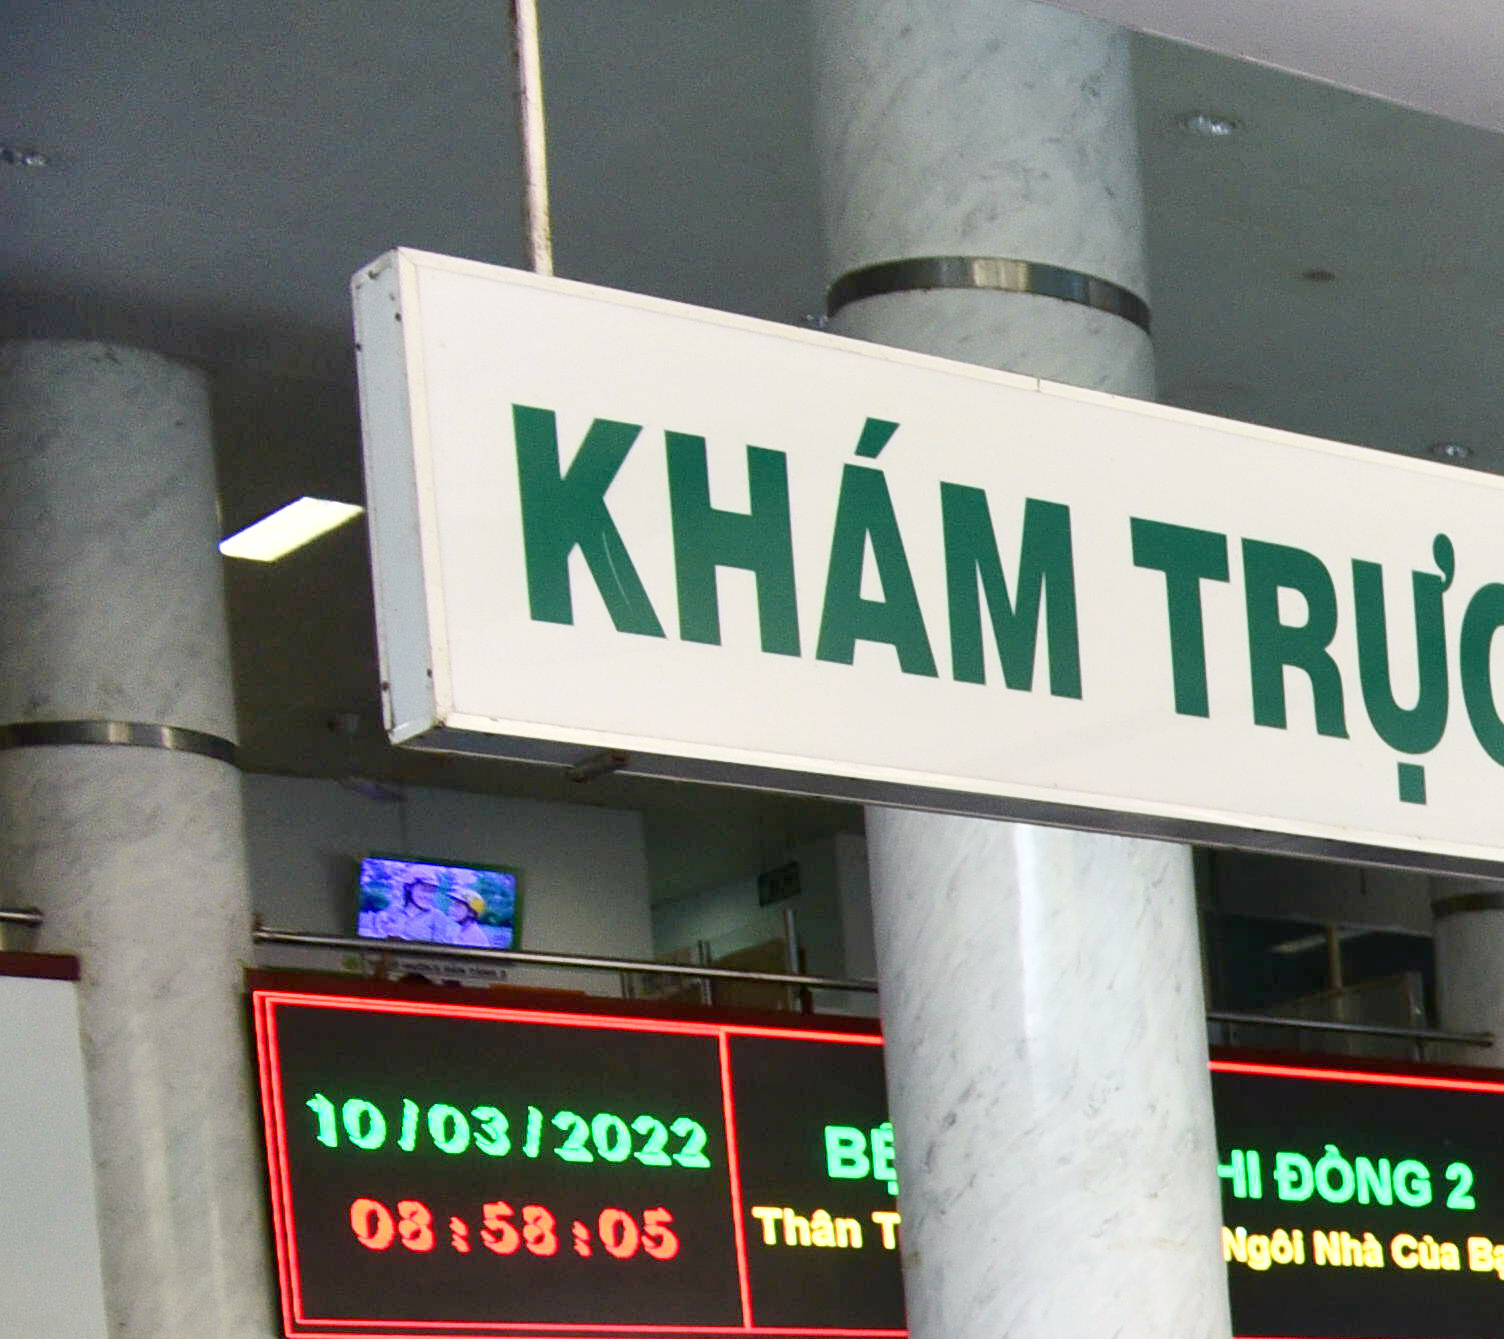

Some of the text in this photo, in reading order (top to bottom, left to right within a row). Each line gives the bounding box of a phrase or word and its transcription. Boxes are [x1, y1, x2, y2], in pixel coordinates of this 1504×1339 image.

[513, 405, 1080, 698] KHÁM
[306, 1093, 710, 1168] 10/03/2022
[1273, 1145, 1432, 1207] ĐỒNG
[1446, 1162, 1475, 1210] 2
[350, 1198, 680, 1262] 08:58:05
[751, 1206, 863, 1249] Thân
[1222, 1226, 1305, 1271] Ngôi
[1313, 1230, 1384, 1268] Nhà
[1391, 1233, 1461, 1271] Của
